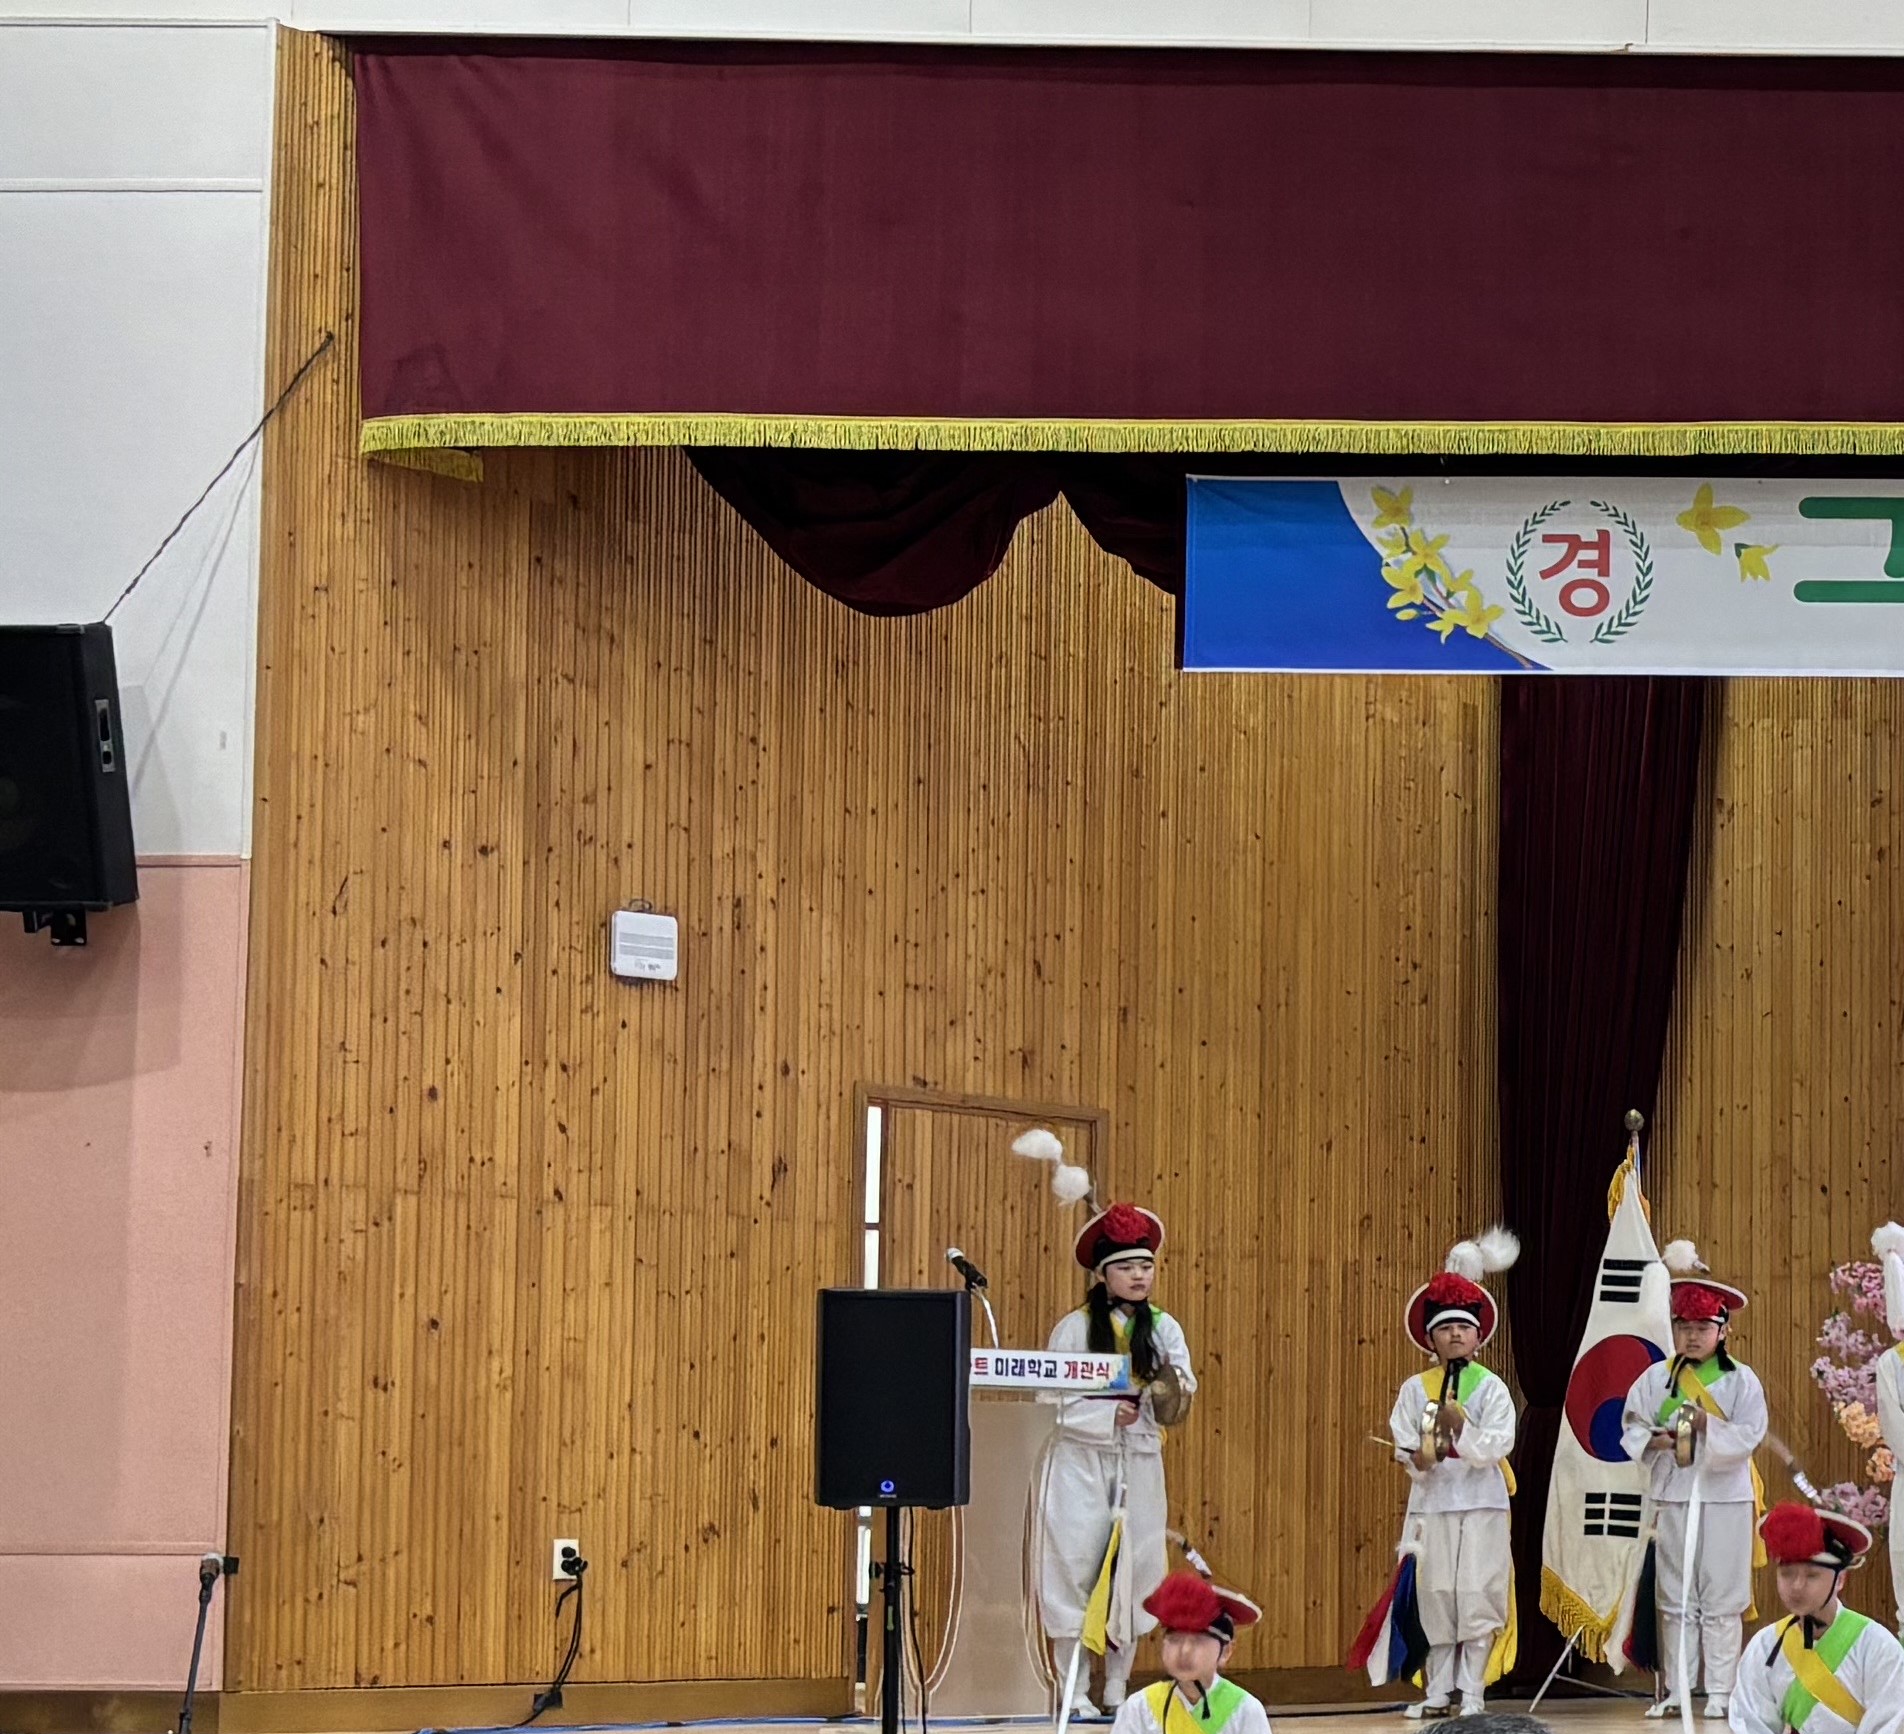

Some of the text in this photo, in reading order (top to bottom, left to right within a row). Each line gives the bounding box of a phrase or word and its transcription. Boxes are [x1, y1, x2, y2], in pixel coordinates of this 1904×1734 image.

[1538, 528, 1612, 618] 경
[994, 1357, 1058, 1379] 미래학교
[1063, 1360, 1110, 1380] 개관식
